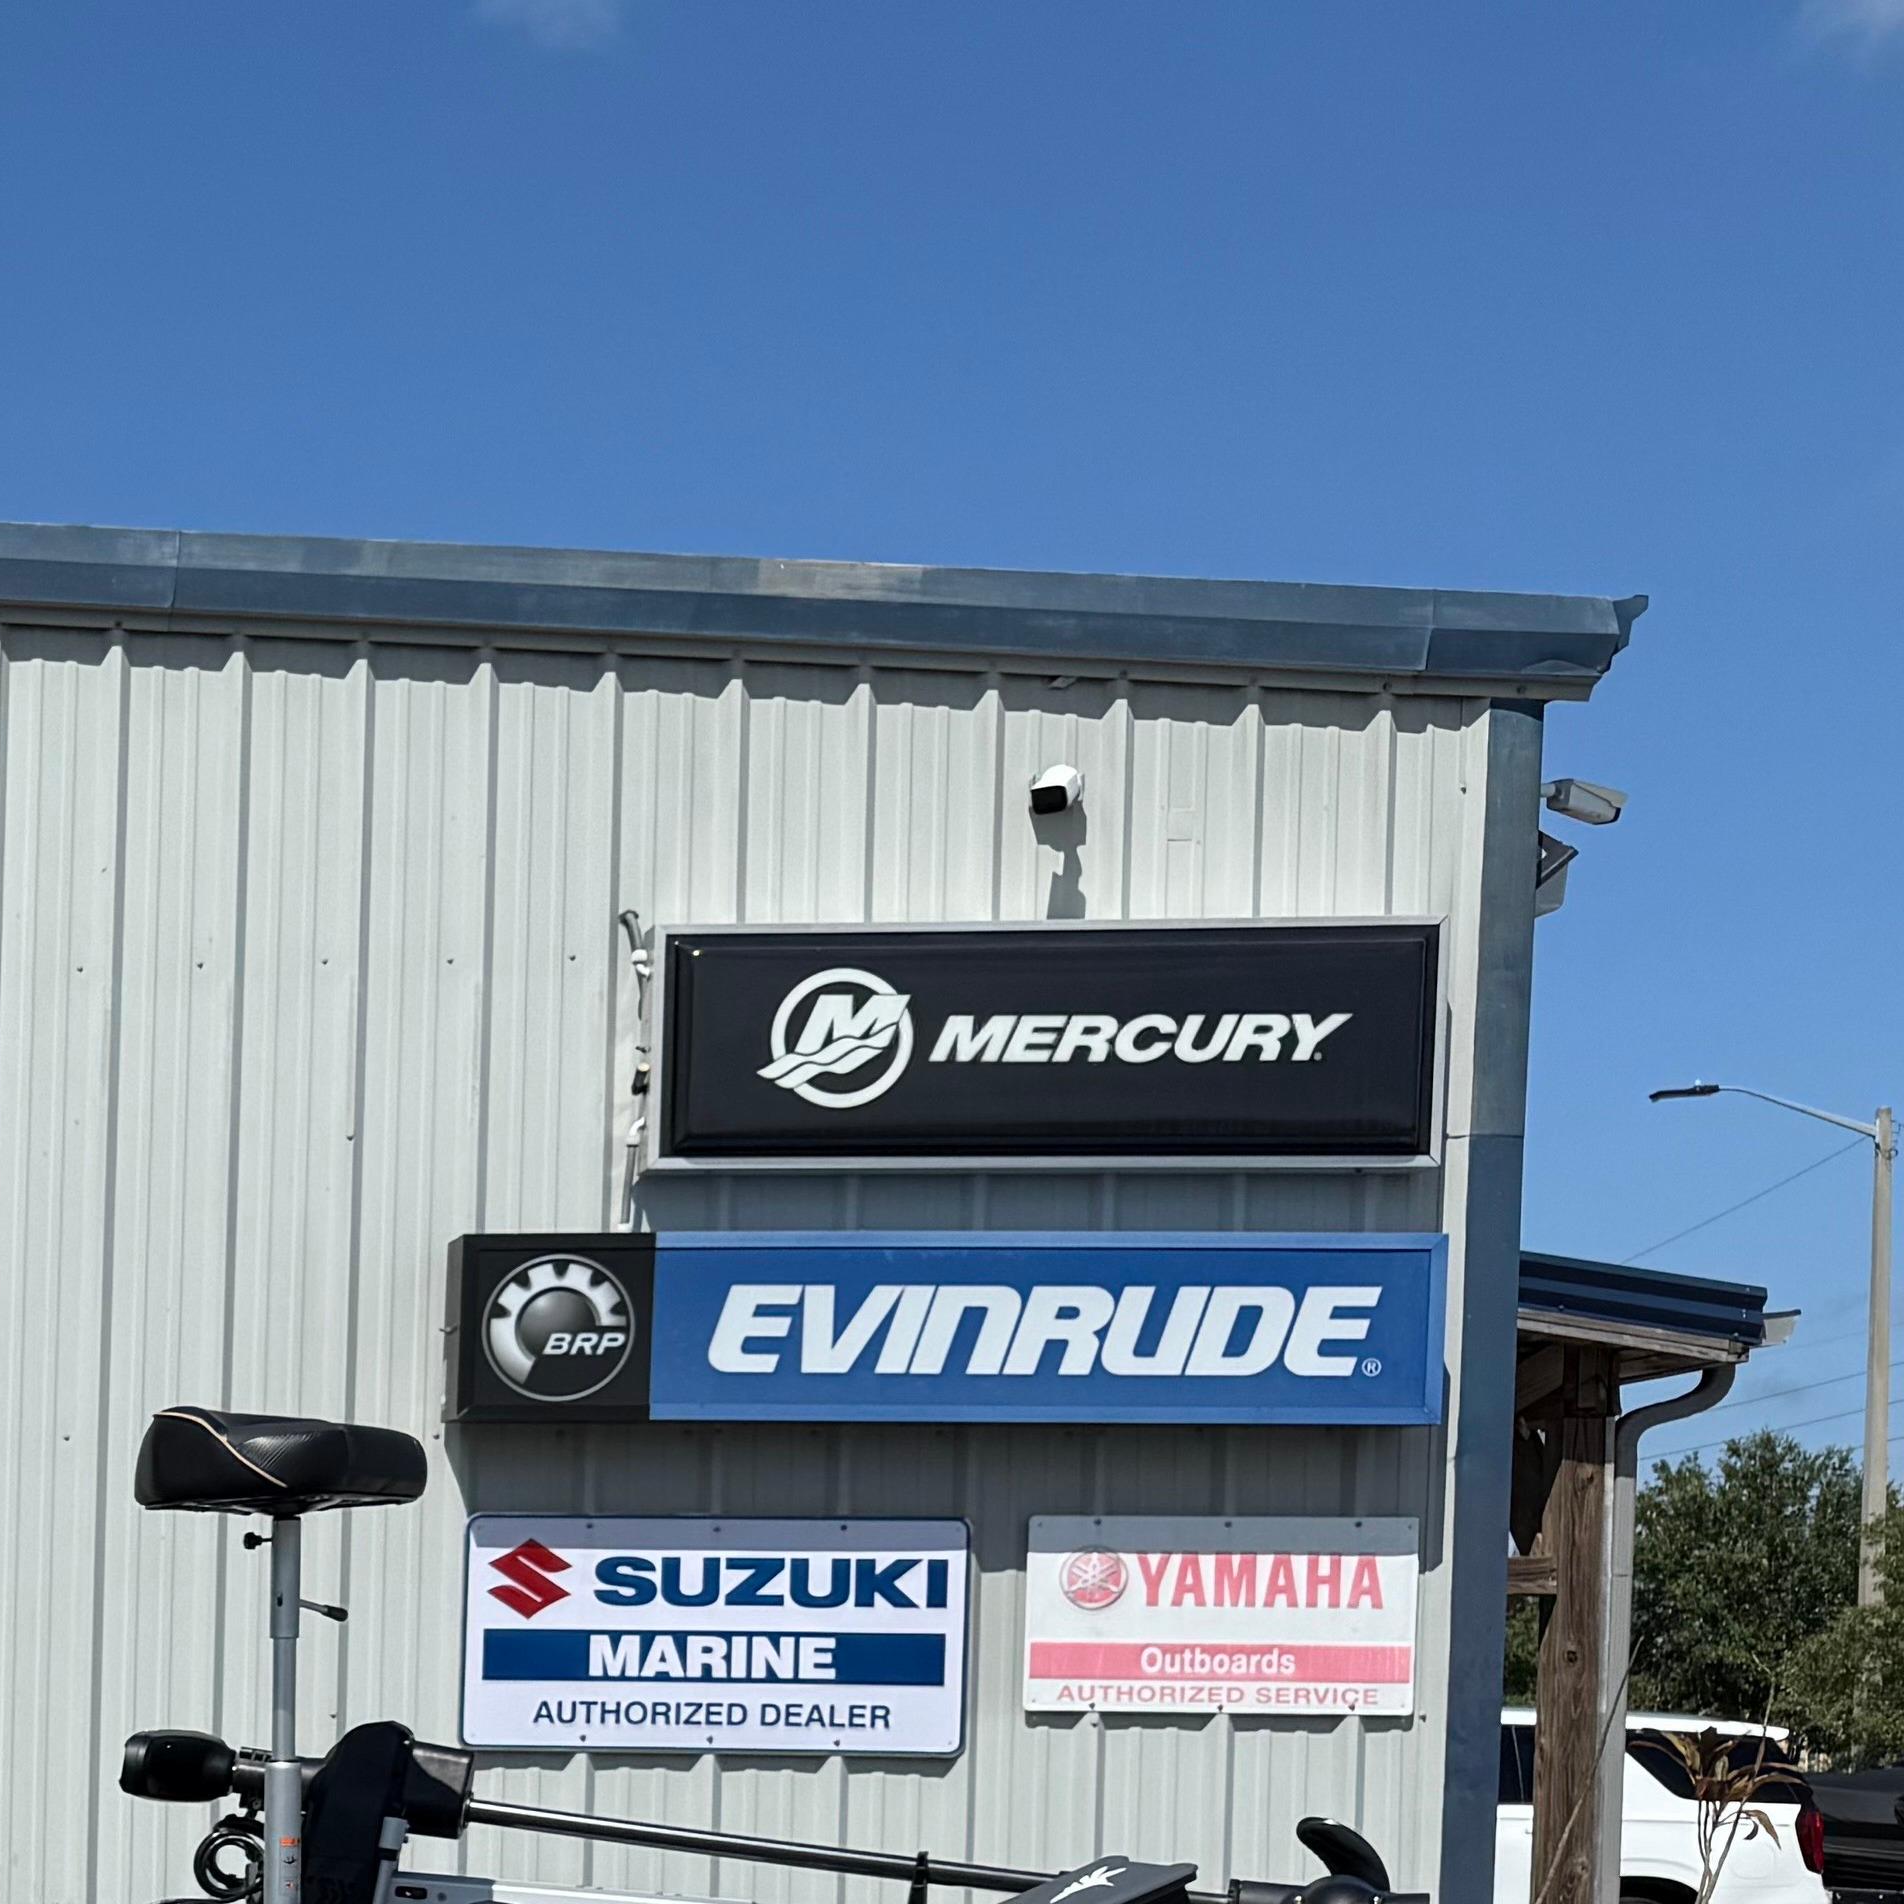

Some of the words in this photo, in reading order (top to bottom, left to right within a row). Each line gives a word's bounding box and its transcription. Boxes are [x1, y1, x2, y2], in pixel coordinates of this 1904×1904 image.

[929, 1013, 1353, 1063] MERCURY
[542, 1332, 626, 1356] BRP
[707, 1284, 1382, 1377] EVINRUDE
[594, 1556, 949, 1609] SUZUKI
[1136, 1550, 1384, 1610] YAMAHA
[588, 1633, 837, 1680] MARINE
[1140, 1646, 1296, 1674] Outboards
[532, 1699, 748, 1726] AUTHORIZED
[759, 1702, 892, 1729] DEALER
[1057, 1684, 1252, 1705] AUTHORIZED
[1255, 1686, 1379, 1706] SERVICE
